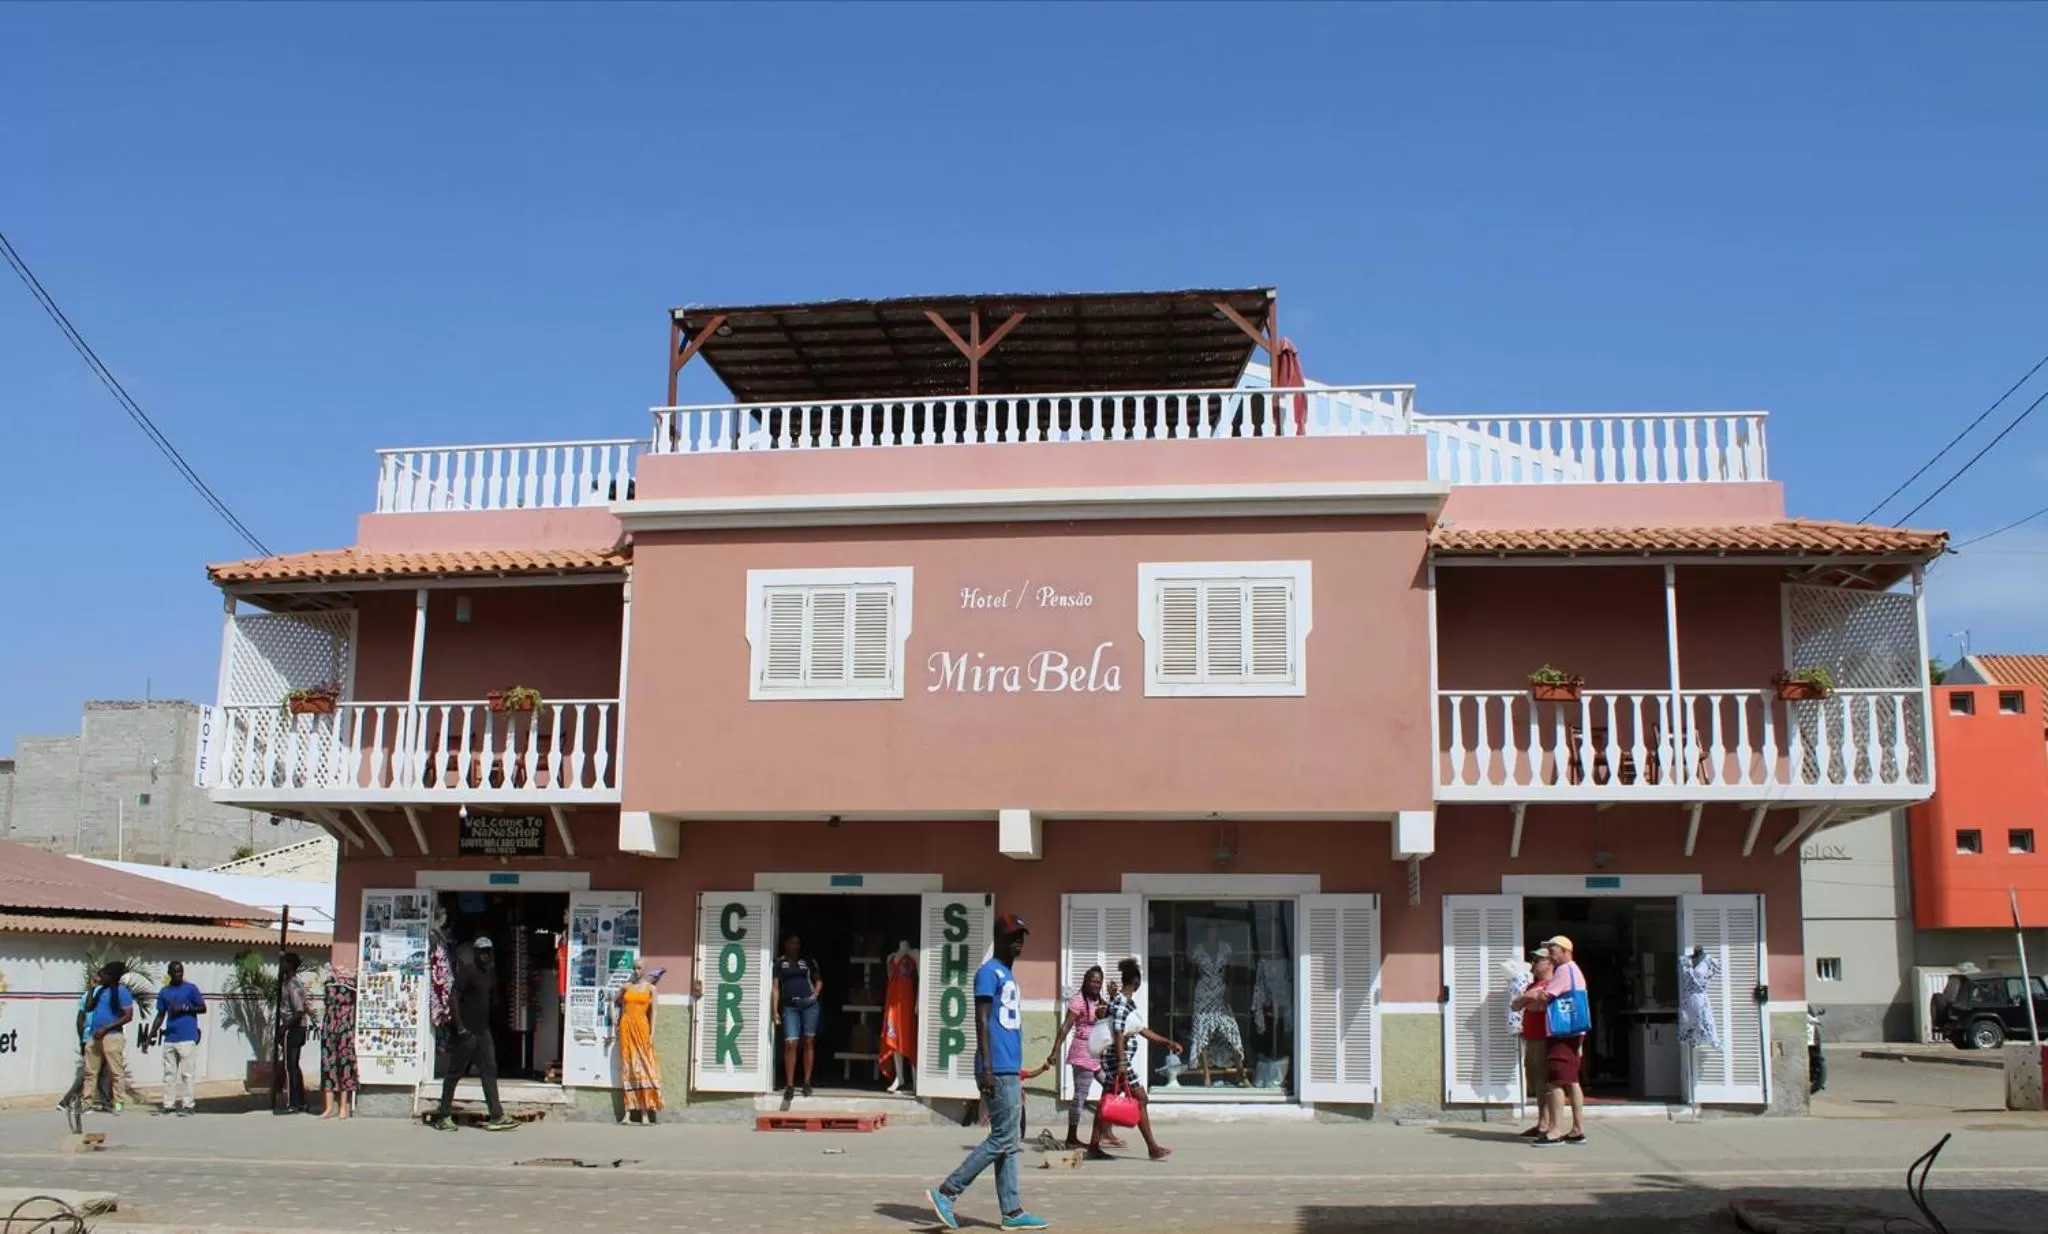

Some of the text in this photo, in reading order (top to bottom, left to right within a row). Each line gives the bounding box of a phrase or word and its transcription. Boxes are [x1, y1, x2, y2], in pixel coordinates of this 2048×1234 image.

[960, 587, 1011, 609] Hotel
[1036, 583, 1093, 607] Pensão
[927, 641, 1122, 692] Mira Bela
[199, 706, 212, 786] HOTEL
[716, 902, 747, 1065] CORK
[938, 903, 969, 1070] SHOP
